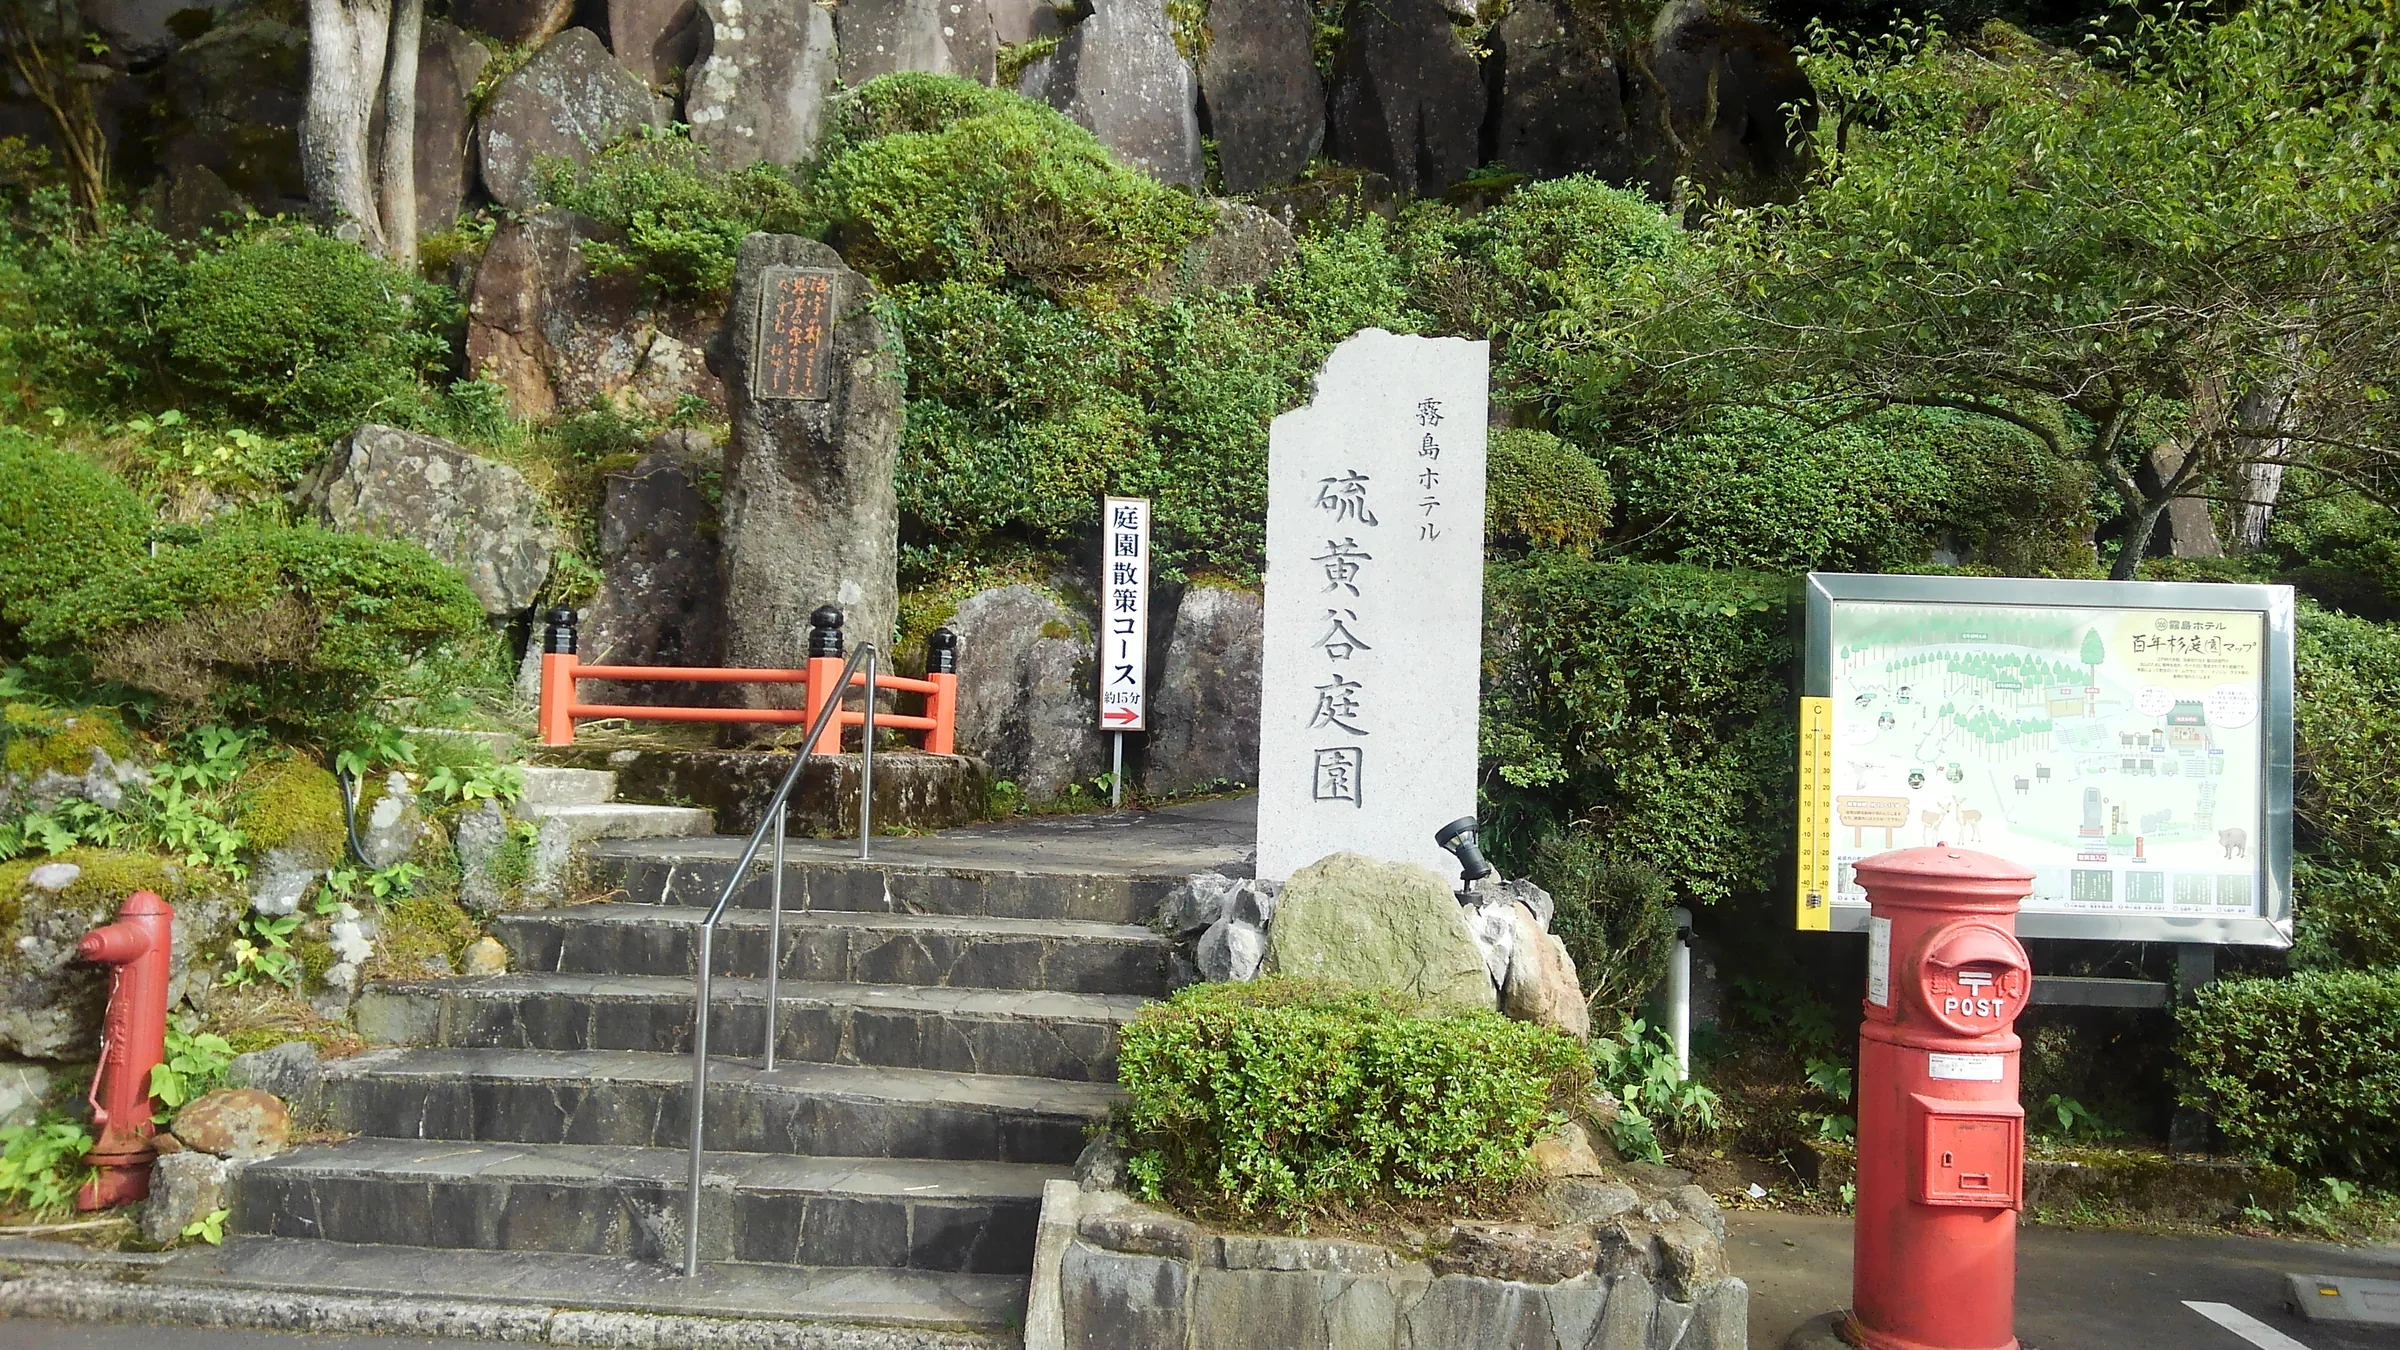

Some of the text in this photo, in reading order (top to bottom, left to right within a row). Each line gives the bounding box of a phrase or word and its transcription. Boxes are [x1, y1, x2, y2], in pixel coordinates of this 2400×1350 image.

[1416, 398, 1445, 542] 霧島ホテル
[1111, 506, 1139, 686] 庭園散策コース
[2169, 620, 2227, 631] 霧島ホテル
[1308, 469, 1379, 810] 硫黄谷庭園
[2132, 634, 2257, 656] 百年杉庭園マップ
[1104, 691, 1141, 704] 約15分
[1944, 997, 2004, 1017] POST
